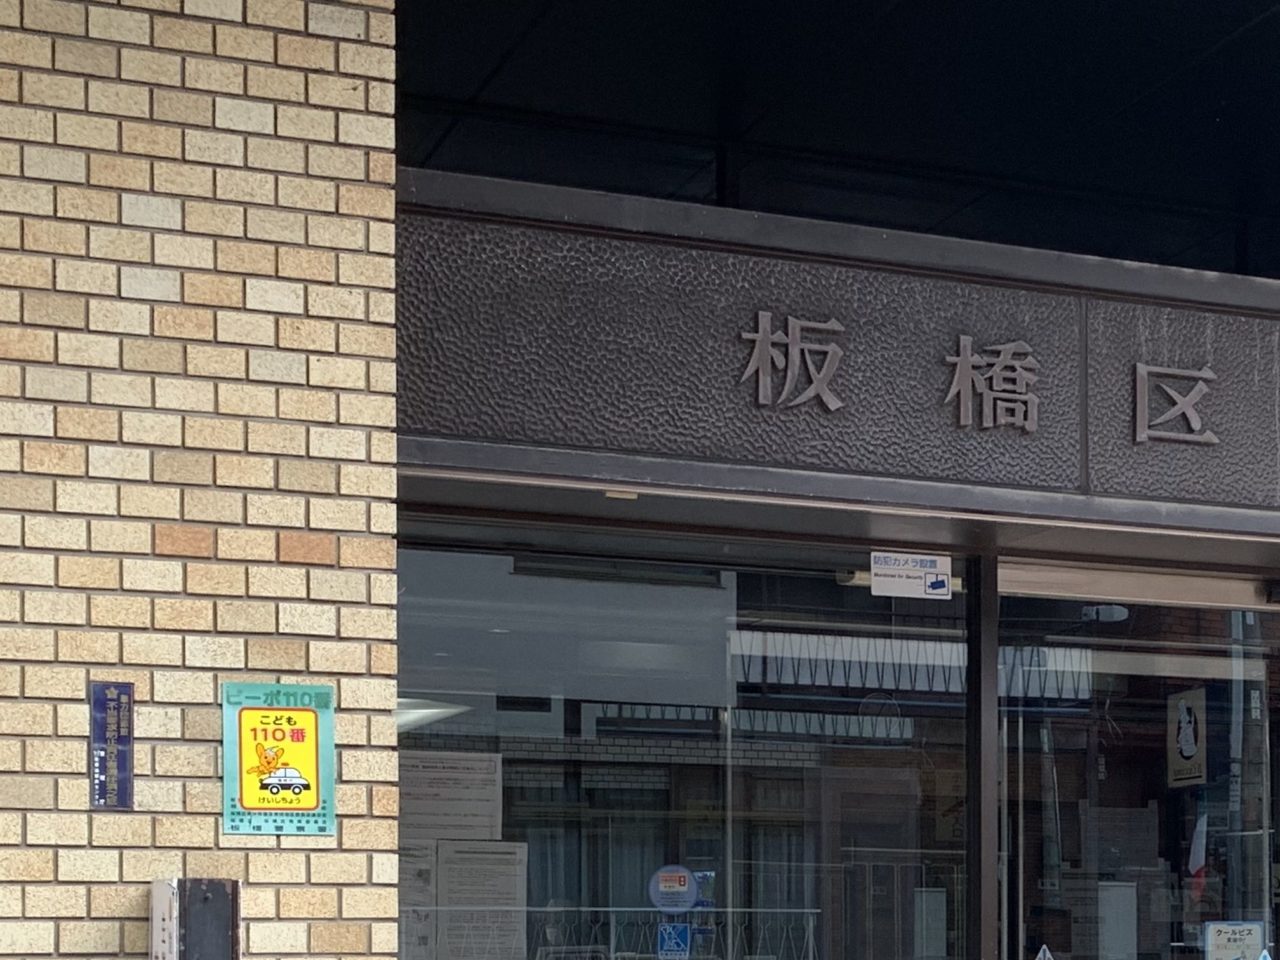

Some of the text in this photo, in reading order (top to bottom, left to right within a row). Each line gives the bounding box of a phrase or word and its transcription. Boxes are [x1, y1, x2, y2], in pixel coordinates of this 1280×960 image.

[259, 715, 297, 726] こども
[250, 727, 306, 743] 110番
[257, 796, 301, 805] けいしちょう
